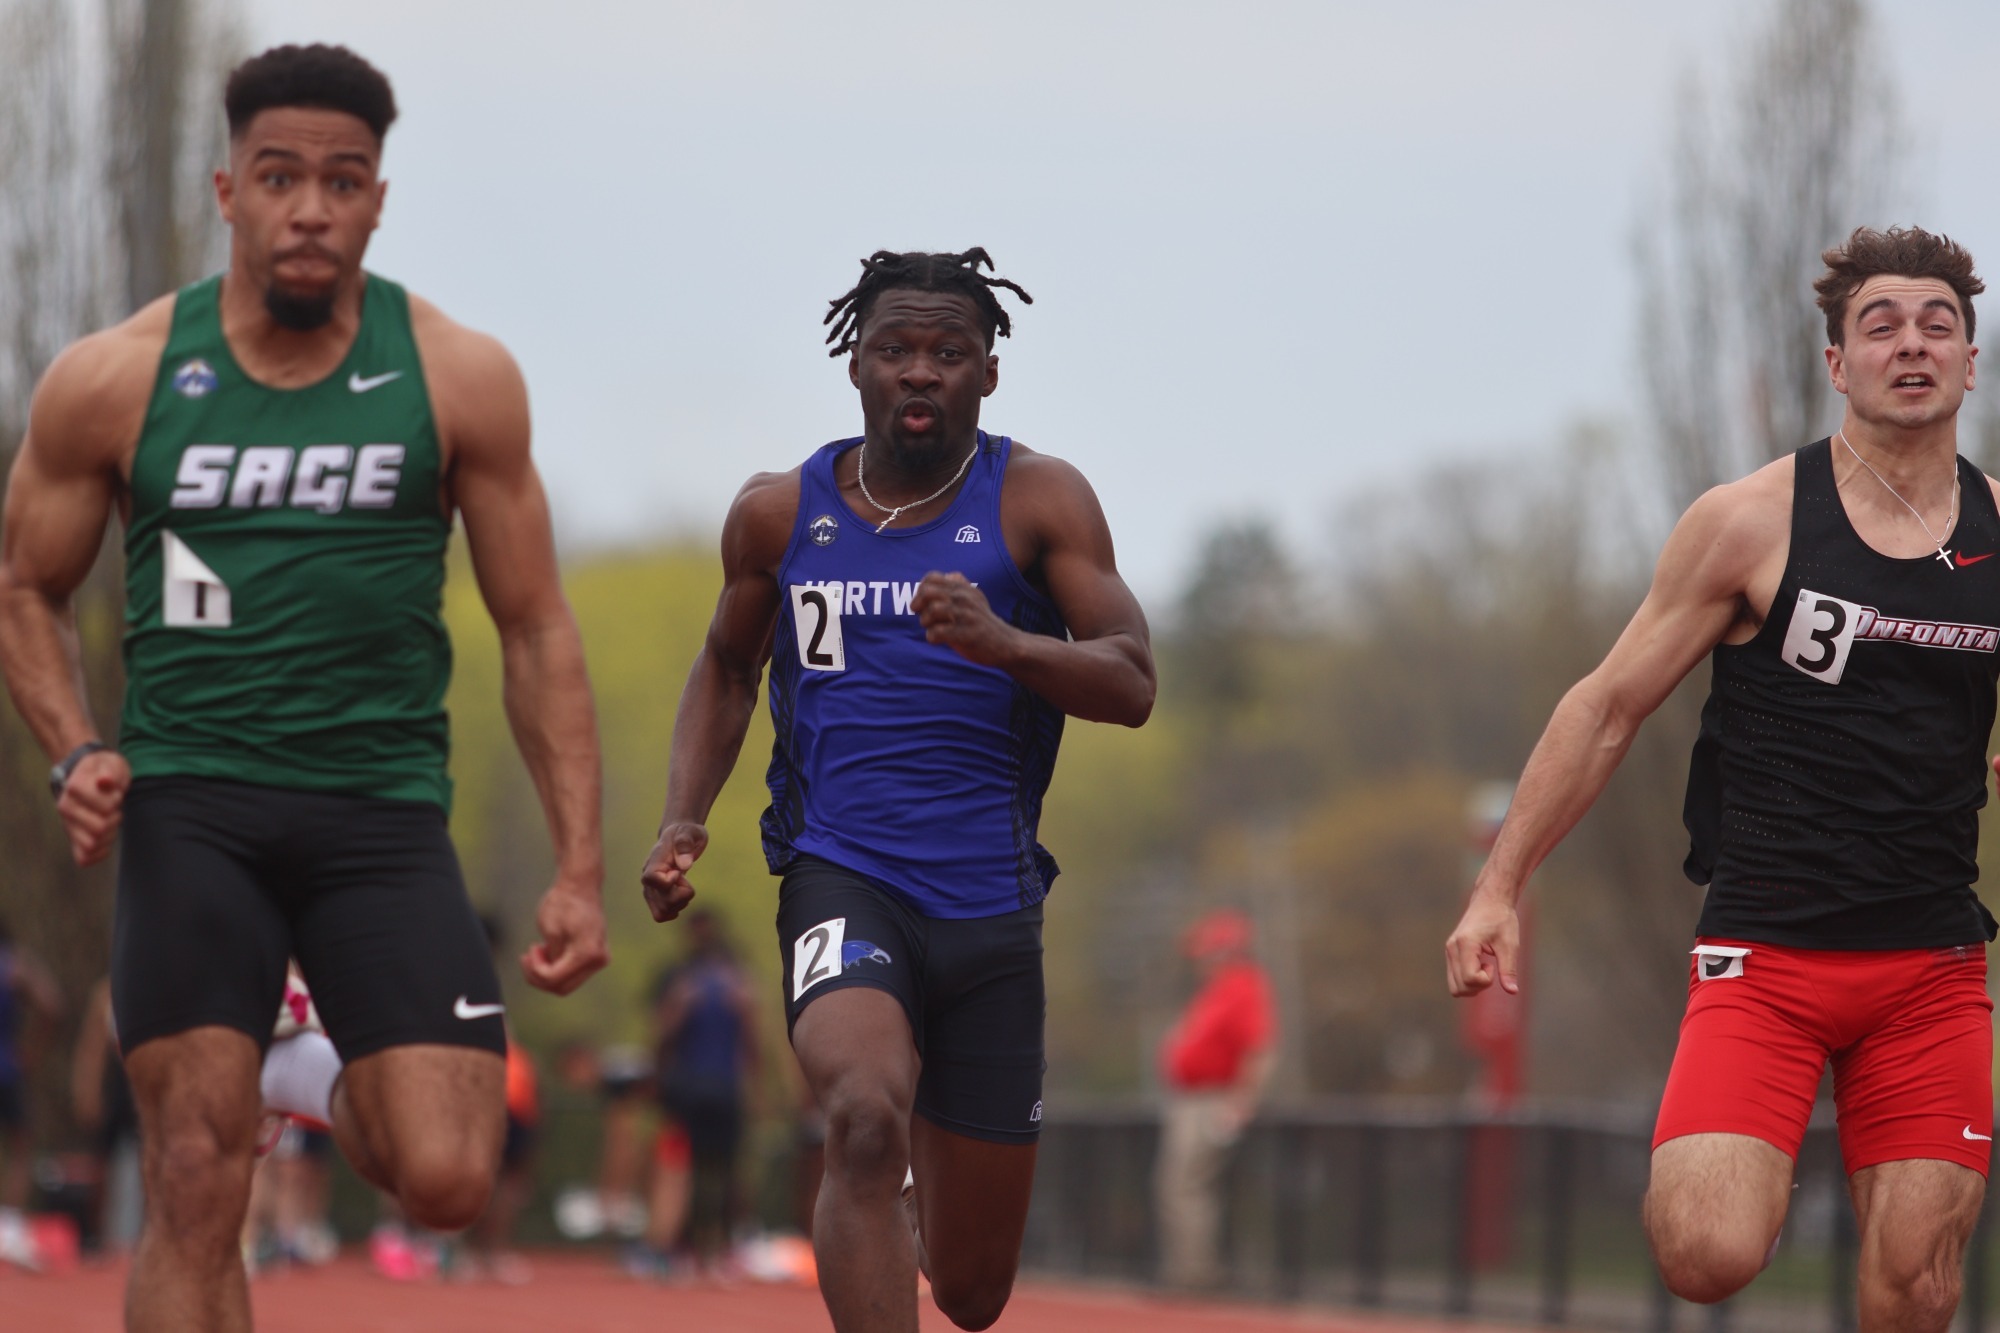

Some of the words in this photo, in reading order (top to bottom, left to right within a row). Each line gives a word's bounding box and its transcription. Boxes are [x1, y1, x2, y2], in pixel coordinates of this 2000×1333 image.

[171, 445, 405, 513] SAGE
[801, 591, 833, 666] 2
[1795, 599, 1847, 673] 3
[803, 928, 830, 989] 2
